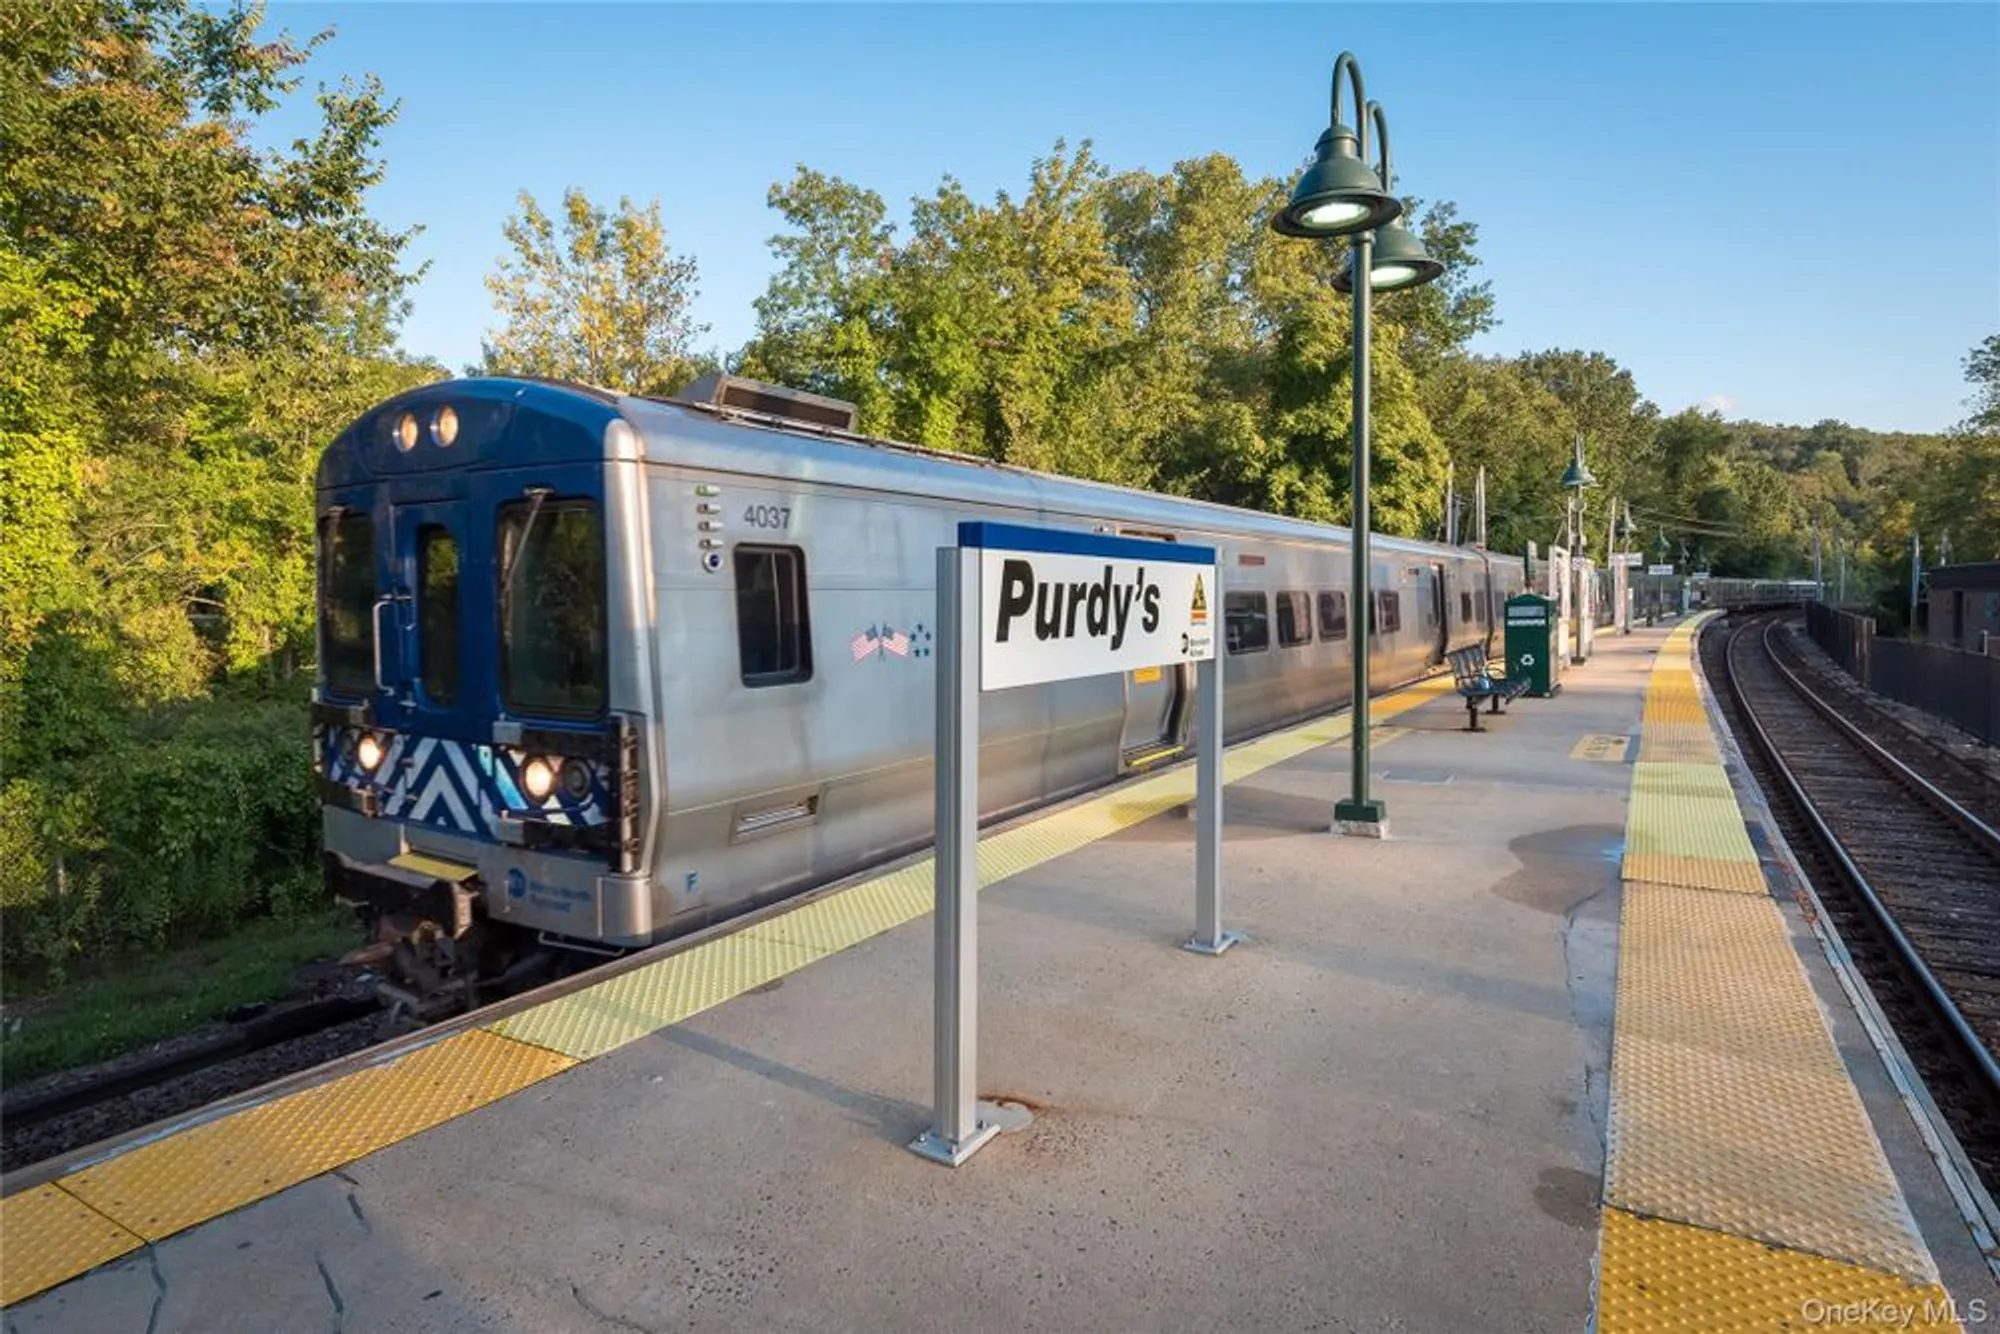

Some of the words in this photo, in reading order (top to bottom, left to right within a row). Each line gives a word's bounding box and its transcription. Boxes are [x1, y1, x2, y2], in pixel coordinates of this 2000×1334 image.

[743, 504, 791, 529] 4037
[995, 558, 1161, 651] Purdy's
[684, 871, 698, 893] F
